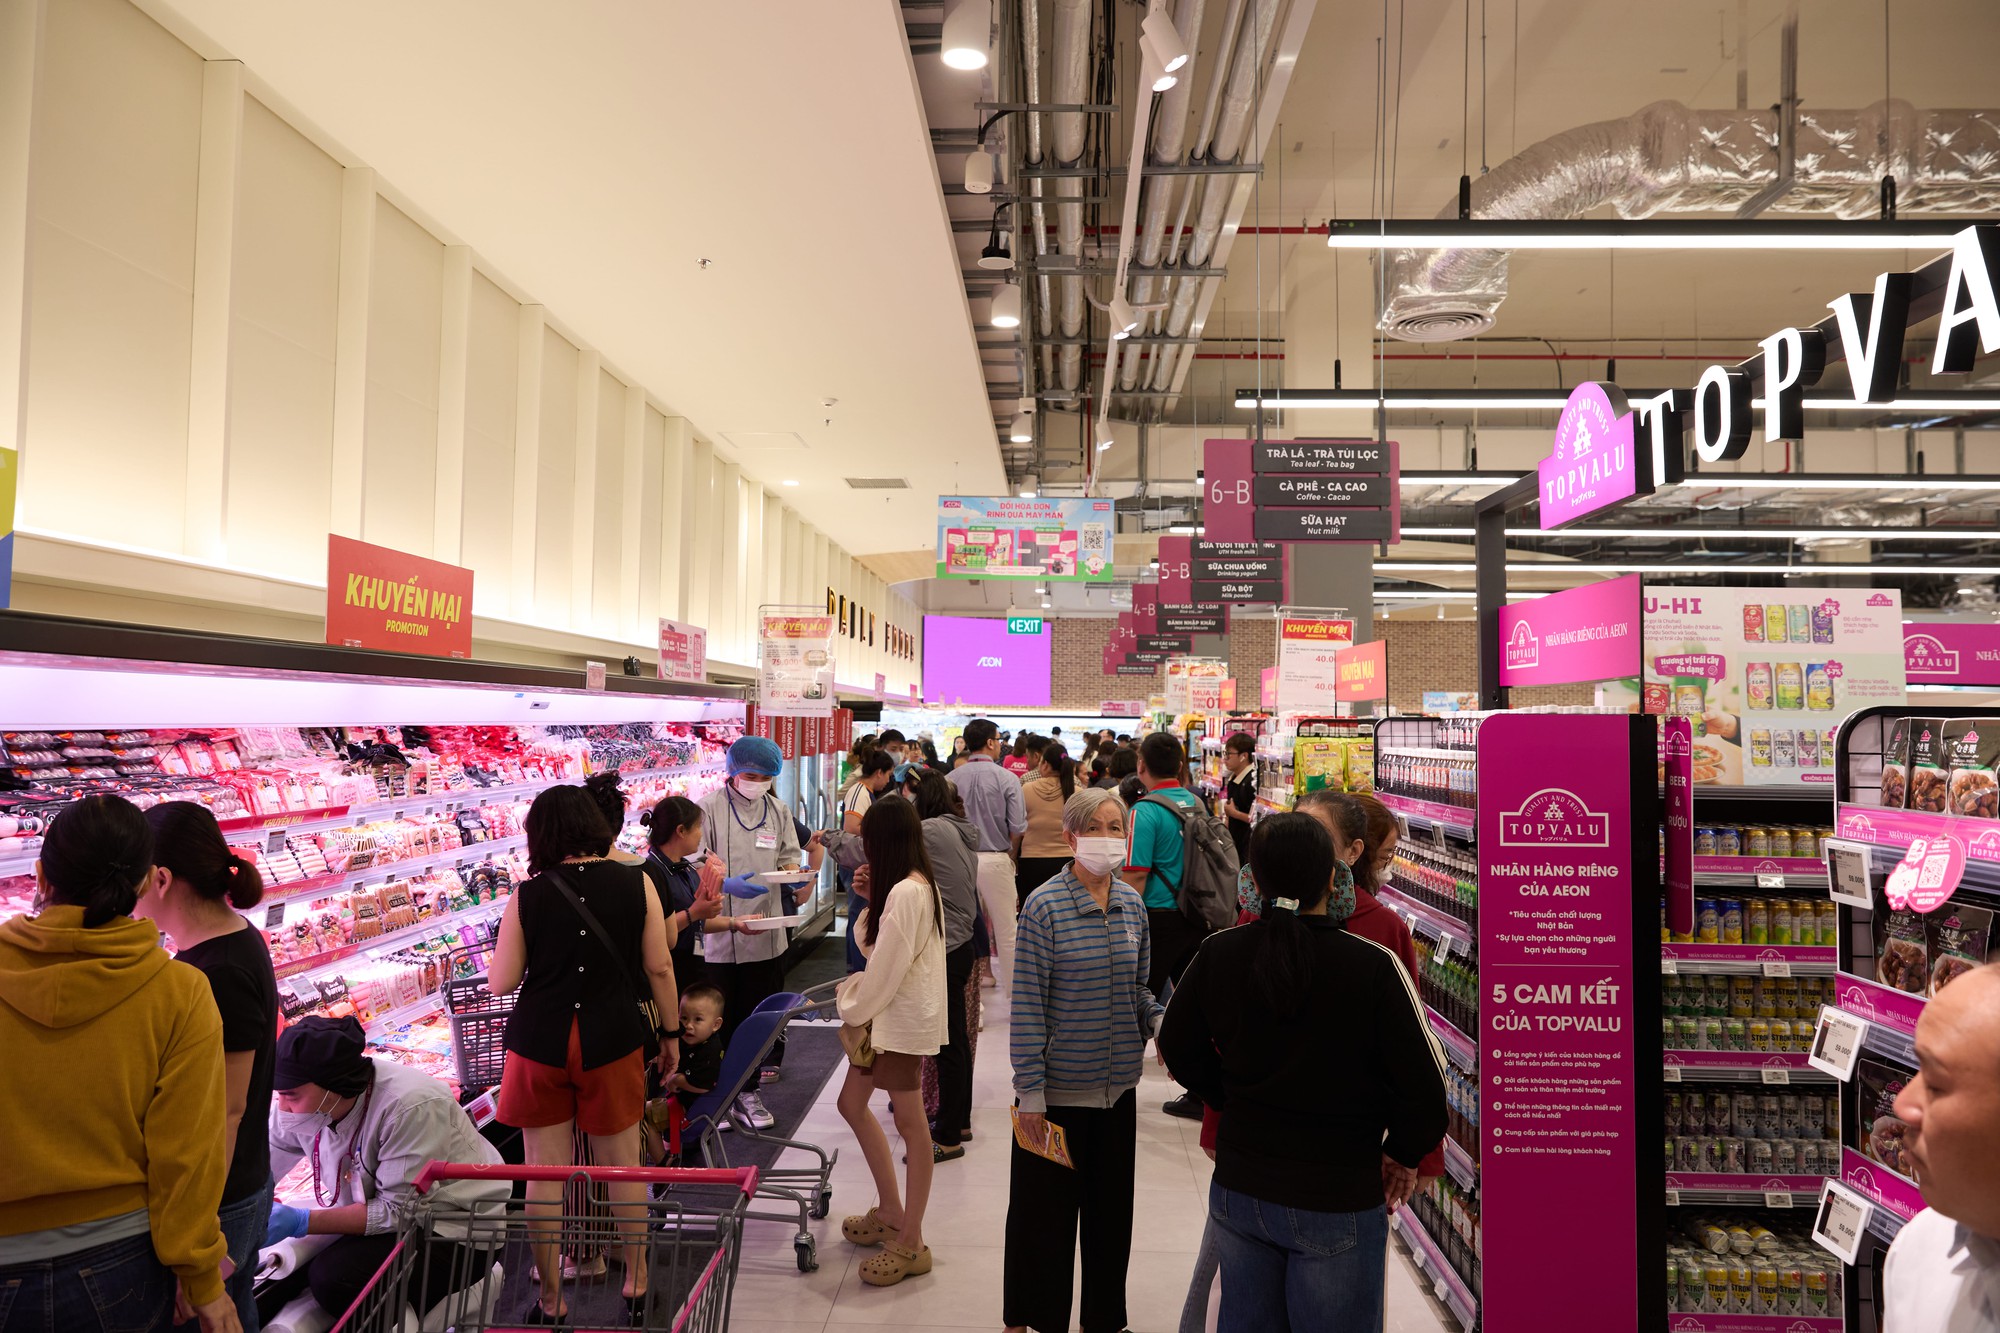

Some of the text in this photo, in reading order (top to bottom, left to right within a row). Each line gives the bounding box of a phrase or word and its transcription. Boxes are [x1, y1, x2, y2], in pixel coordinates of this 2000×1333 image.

[1578, 398, 1591, 411] AND
[1592, 401, 1609, 436] TRUST
[1267, 447, 1288, 458] TRÀ
[1291, 448, 1304, 458] LÁ
[1314, 448, 1334, 458] TRÀ
[1358, 450, 1378, 461] LỌC
[1341, 461, 1354, 469] bag
[1546, 443, 1625, 504] TOPVALU
[1211, 480, 1250, 504] 6-B
[1280, 480, 1367, 491] CÀ PHÊ CA CAO
[1301, 515, 1347, 527] SỮA HẠT
[1161, 563, 1189, 579] 5-B
[345, 575, 462, 629] KHUYẾN MẠI
[1644, 598, 1702, 614] U-HI
[827, 586, 876, 646] DAILY
[1134, 603, 1155, 616] 4-B
[1825, 606, 1838, 614] 3%
[386, 619, 429, 637] PROMOTION
[1016, 620, 1040, 632] EXIT
[1286, 621, 1327, 633] KHUYẾN
[1561, 629, 1576, 644] HÀNG
[1577, 626, 1594, 642] RIÊNG
[1610, 622, 1628, 638] AEON
[1509, 648, 1536, 660] TOPVALU
[1909, 649, 2000, 667] PVALU NHÃ
[1685, 656, 1692, 664] vị
[1707, 656, 1719, 666] cây
[1687, 666, 1704, 675] dạng
[1669, 775, 1686, 788] BEER
[1525, 796, 1548, 817] QUALITY
[1567, 800, 1583, 817] TRUST
[1675, 796, 1681, 807] &
[1668, 815, 1688, 830] RƯỢU
[1510, 824, 1598, 835] TOPVALU
[1845, 830, 1874, 840] TOPVALU
[1889, 830, 1903, 839] NHÃN
[1491, 863, 1618, 877] NHÃN HÀNG RIÊNG
[1519, 881, 1590, 896] CỦA AEON
[1531, 910, 1556, 918] chuẩn
[1559, 910, 1576, 918] chất
[1579, 912, 1601, 920] lượng
[1537, 922, 1555, 930] Nhật
[1512, 935, 1524, 943] lựa
[1527, 935, 1546, 943] chọn
[1566, 935, 1590, 943] những
[1593, 935, 1616, 943] người
[1559, 947, 1587, 955] thương
[1493, 977, 1620, 1005] 5 CAM KẾT
[1810, 1000, 1816, 1008] 9
[1845, 1001, 1872, 1015] TOPVALU
[1886, 1010, 1900, 1020] NHÃN
[1492, 1010, 1621, 1032] CỦA TOPVALU
[1766, 1300, 1772, 1308] 9
[1817, 1302, 1823, 1310] 9
